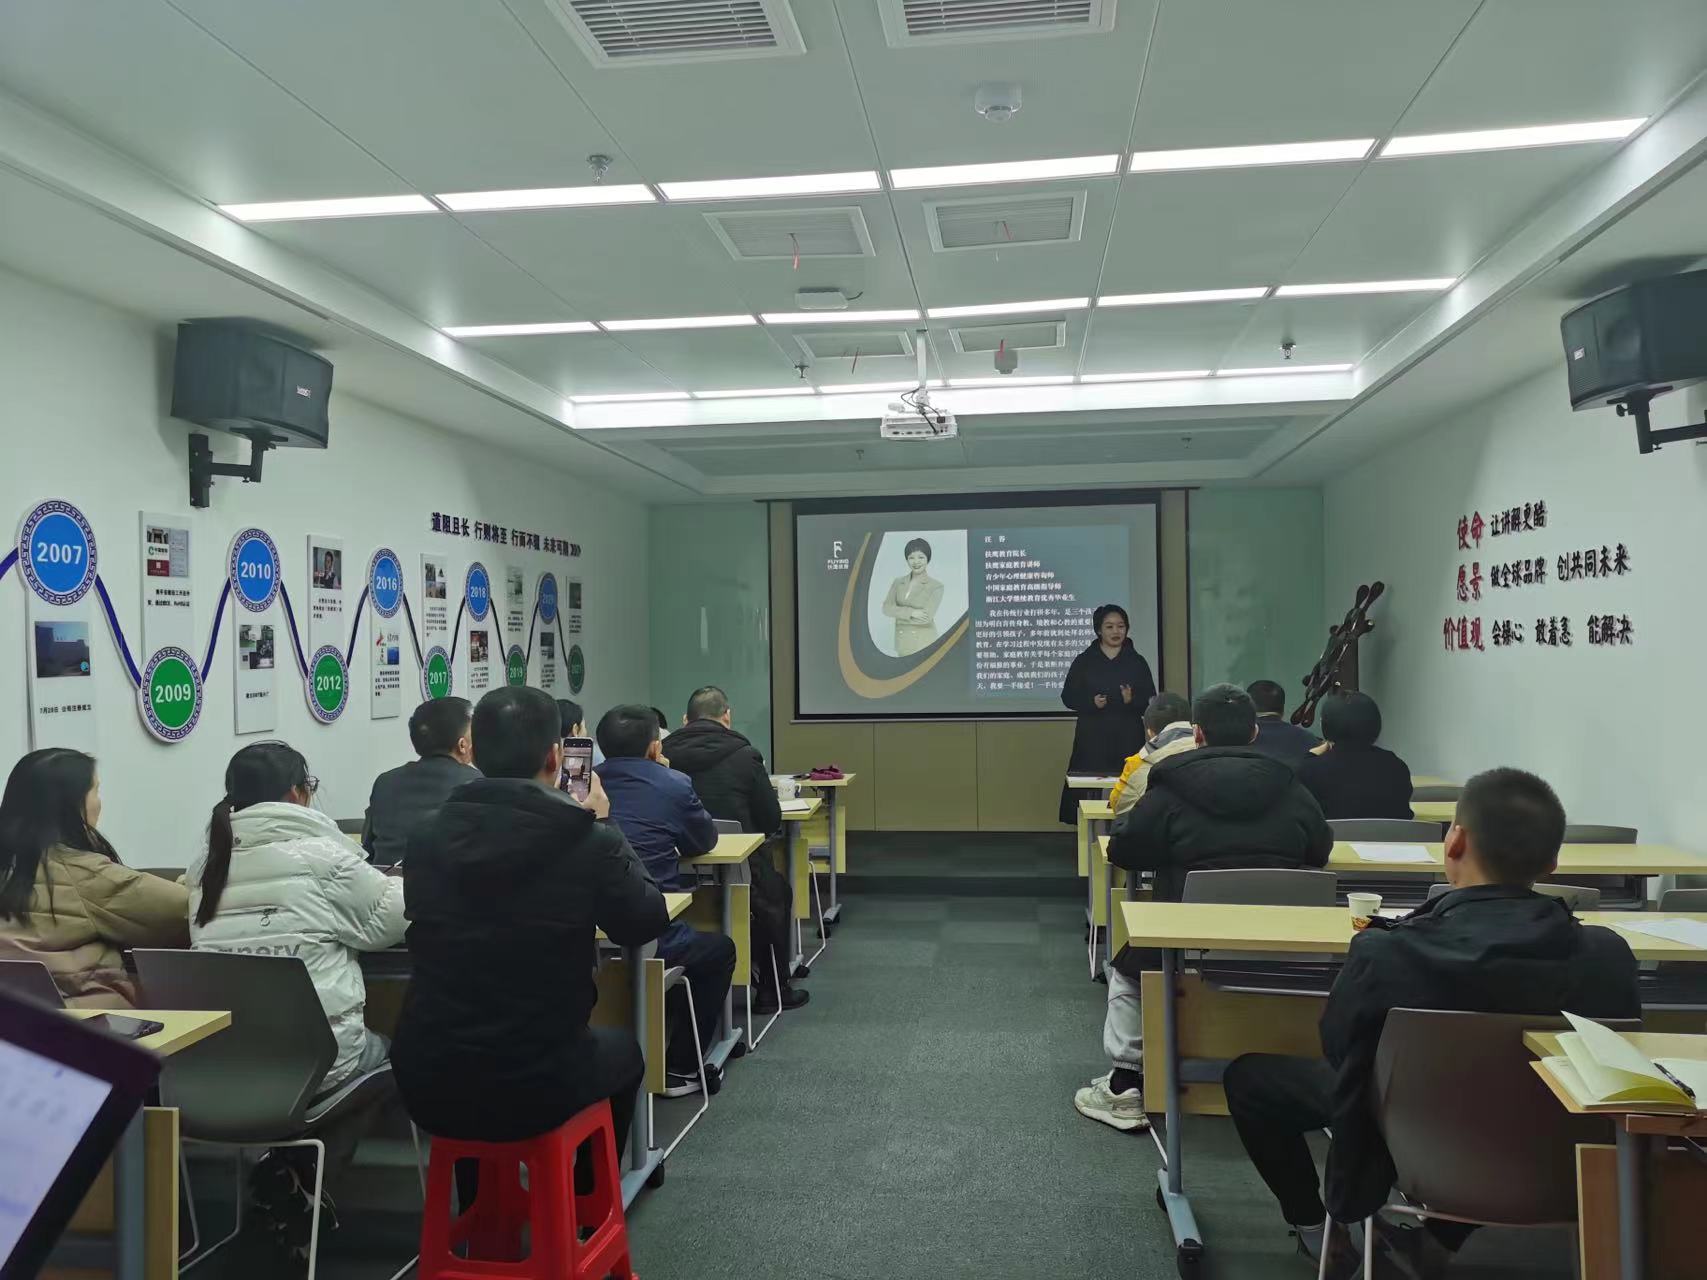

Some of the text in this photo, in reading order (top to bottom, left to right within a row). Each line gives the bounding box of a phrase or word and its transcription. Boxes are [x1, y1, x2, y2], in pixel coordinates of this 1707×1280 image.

[431, 512, 470, 537] 道阻且长
[474, 520, 507, 544] 行则将至
[1456, 500, 1548, 550] 使命 让讲解更酷
[37, 542, 83, 565] 2007
[240, 562, 271, 580] 2010
[1456, 543, 1631, 601] 愿景 做全球品牌 创共同未来
[376, 576, 398, 591] 2016
[470, 585, 486, 599] 2018
[1587, 614, 1635, 646] 能解决
[429, 671, 447, 686] 2017
[509, 667, 523, 679] 2019
[316, 675, 342, 692] 2012
[155, 684, 191, 703] 2009
